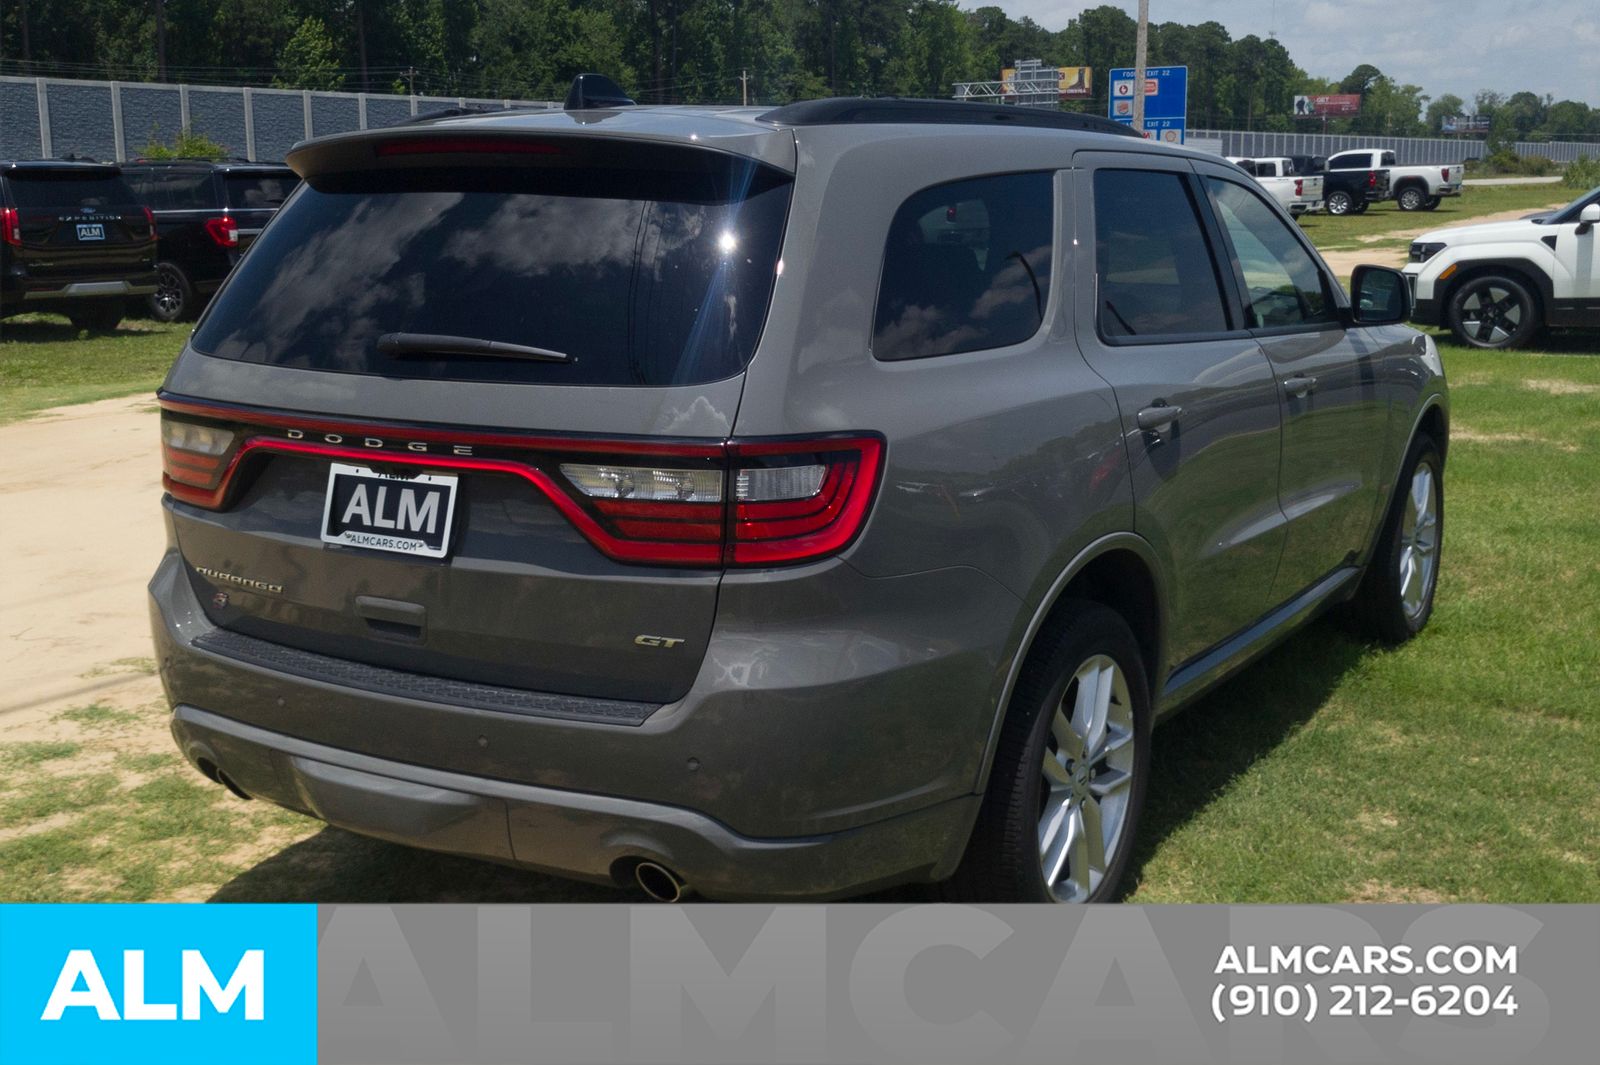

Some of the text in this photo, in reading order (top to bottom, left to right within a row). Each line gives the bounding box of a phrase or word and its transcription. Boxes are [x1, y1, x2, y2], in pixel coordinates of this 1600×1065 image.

[80, 227, 100, 237] ALM
[287, 429, 473, 456] DODGE
[341, 483, 441, 534] ALM
[350, 533, 417, 552] ALMCARS.COM
[634, 634, 686, 648] GT
